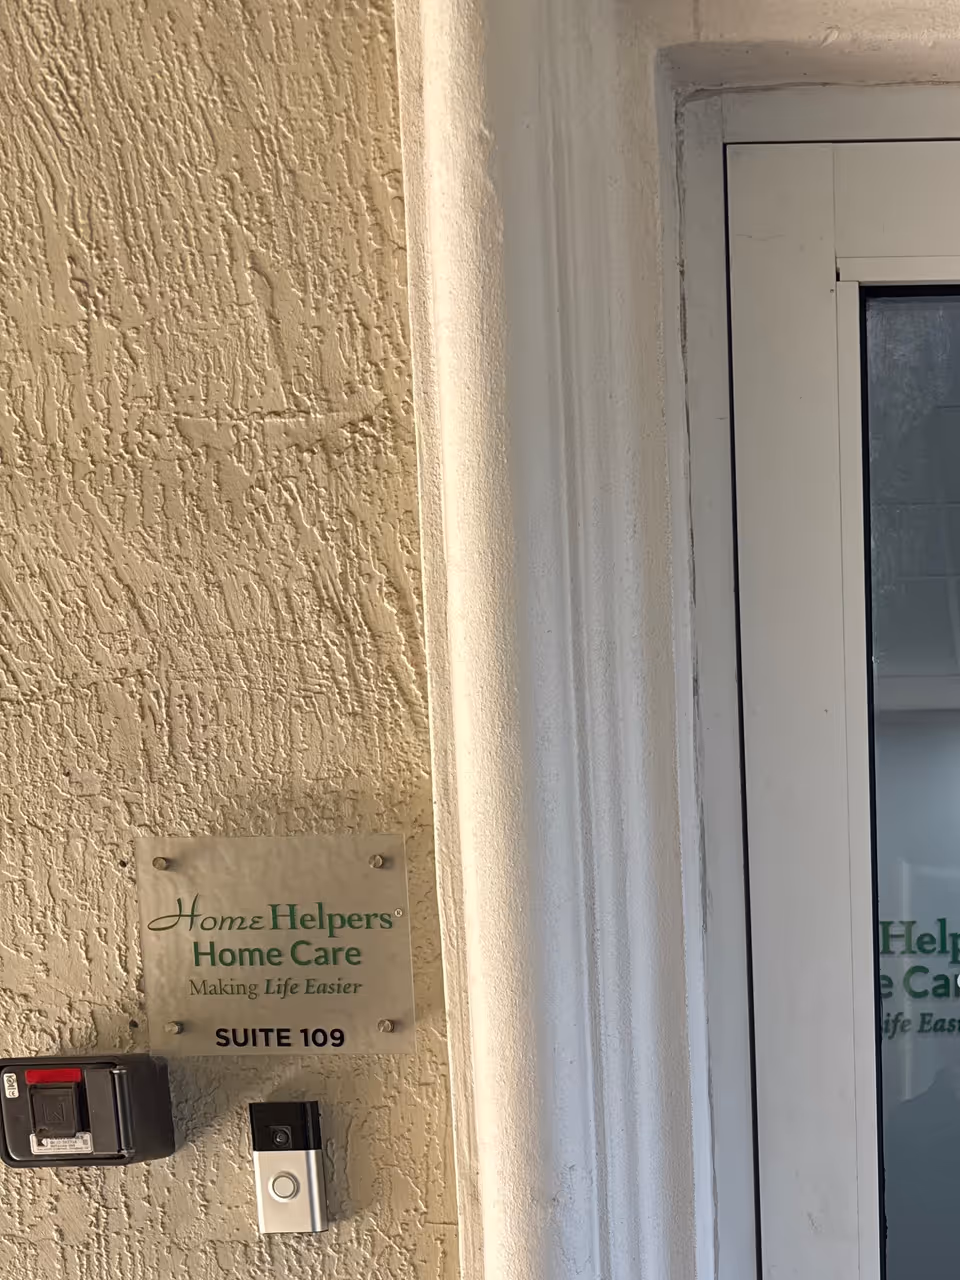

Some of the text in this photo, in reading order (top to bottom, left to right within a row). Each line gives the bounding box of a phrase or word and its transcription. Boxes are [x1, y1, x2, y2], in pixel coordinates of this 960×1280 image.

[147, 892, 266, 932] Home
[193, 939, 362, 967] Home Care
[188, 977, 363, 1000] Making Life Easier
[215, 1027, 346, 1048] SUITE 109
[882, 1011, 912, 1040] ife
